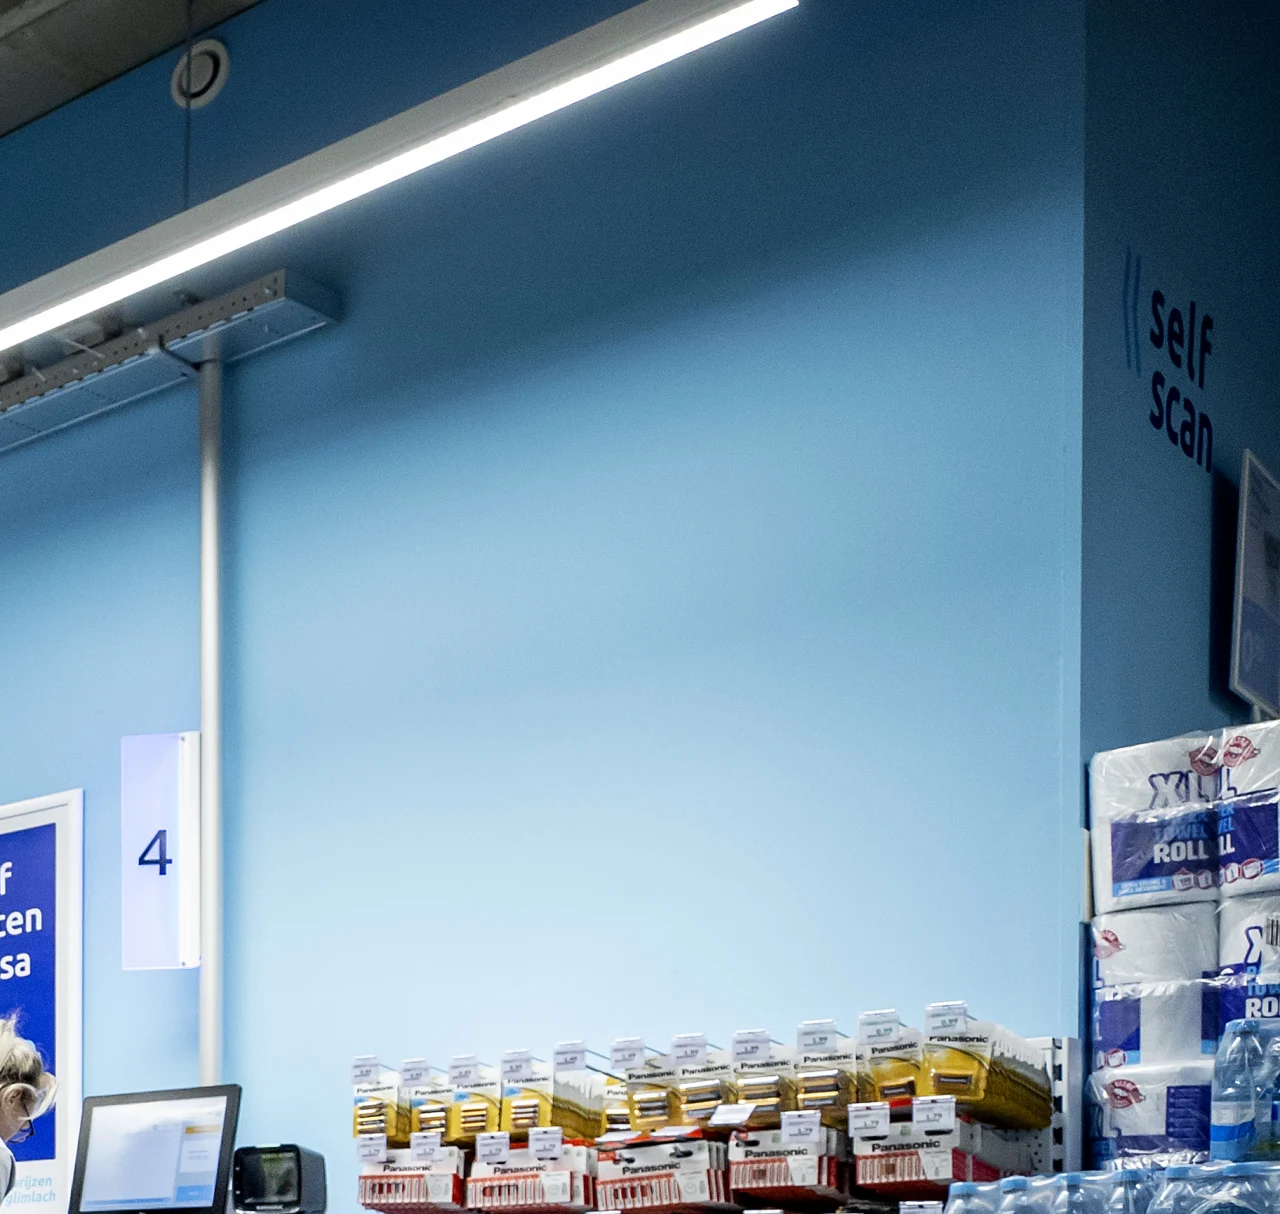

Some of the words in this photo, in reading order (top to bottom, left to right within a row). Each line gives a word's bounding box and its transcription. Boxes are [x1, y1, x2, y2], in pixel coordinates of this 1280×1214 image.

[1150, 289, 1214, 389] self
[1150, 371, 1214, 473] scan
[138, 830, 172, 875] 4
[1153, 840, 1209, 864] ROLL
[629, 1069, 676, 1080] Panasonic
[745, 1147, 808, 1158] Panasonic
[872, 1139, 940, 1152] Panasonic
[383, 1164, 432, 1172] Panasonic
[622, 1161, 681, 1175] Panasonic
